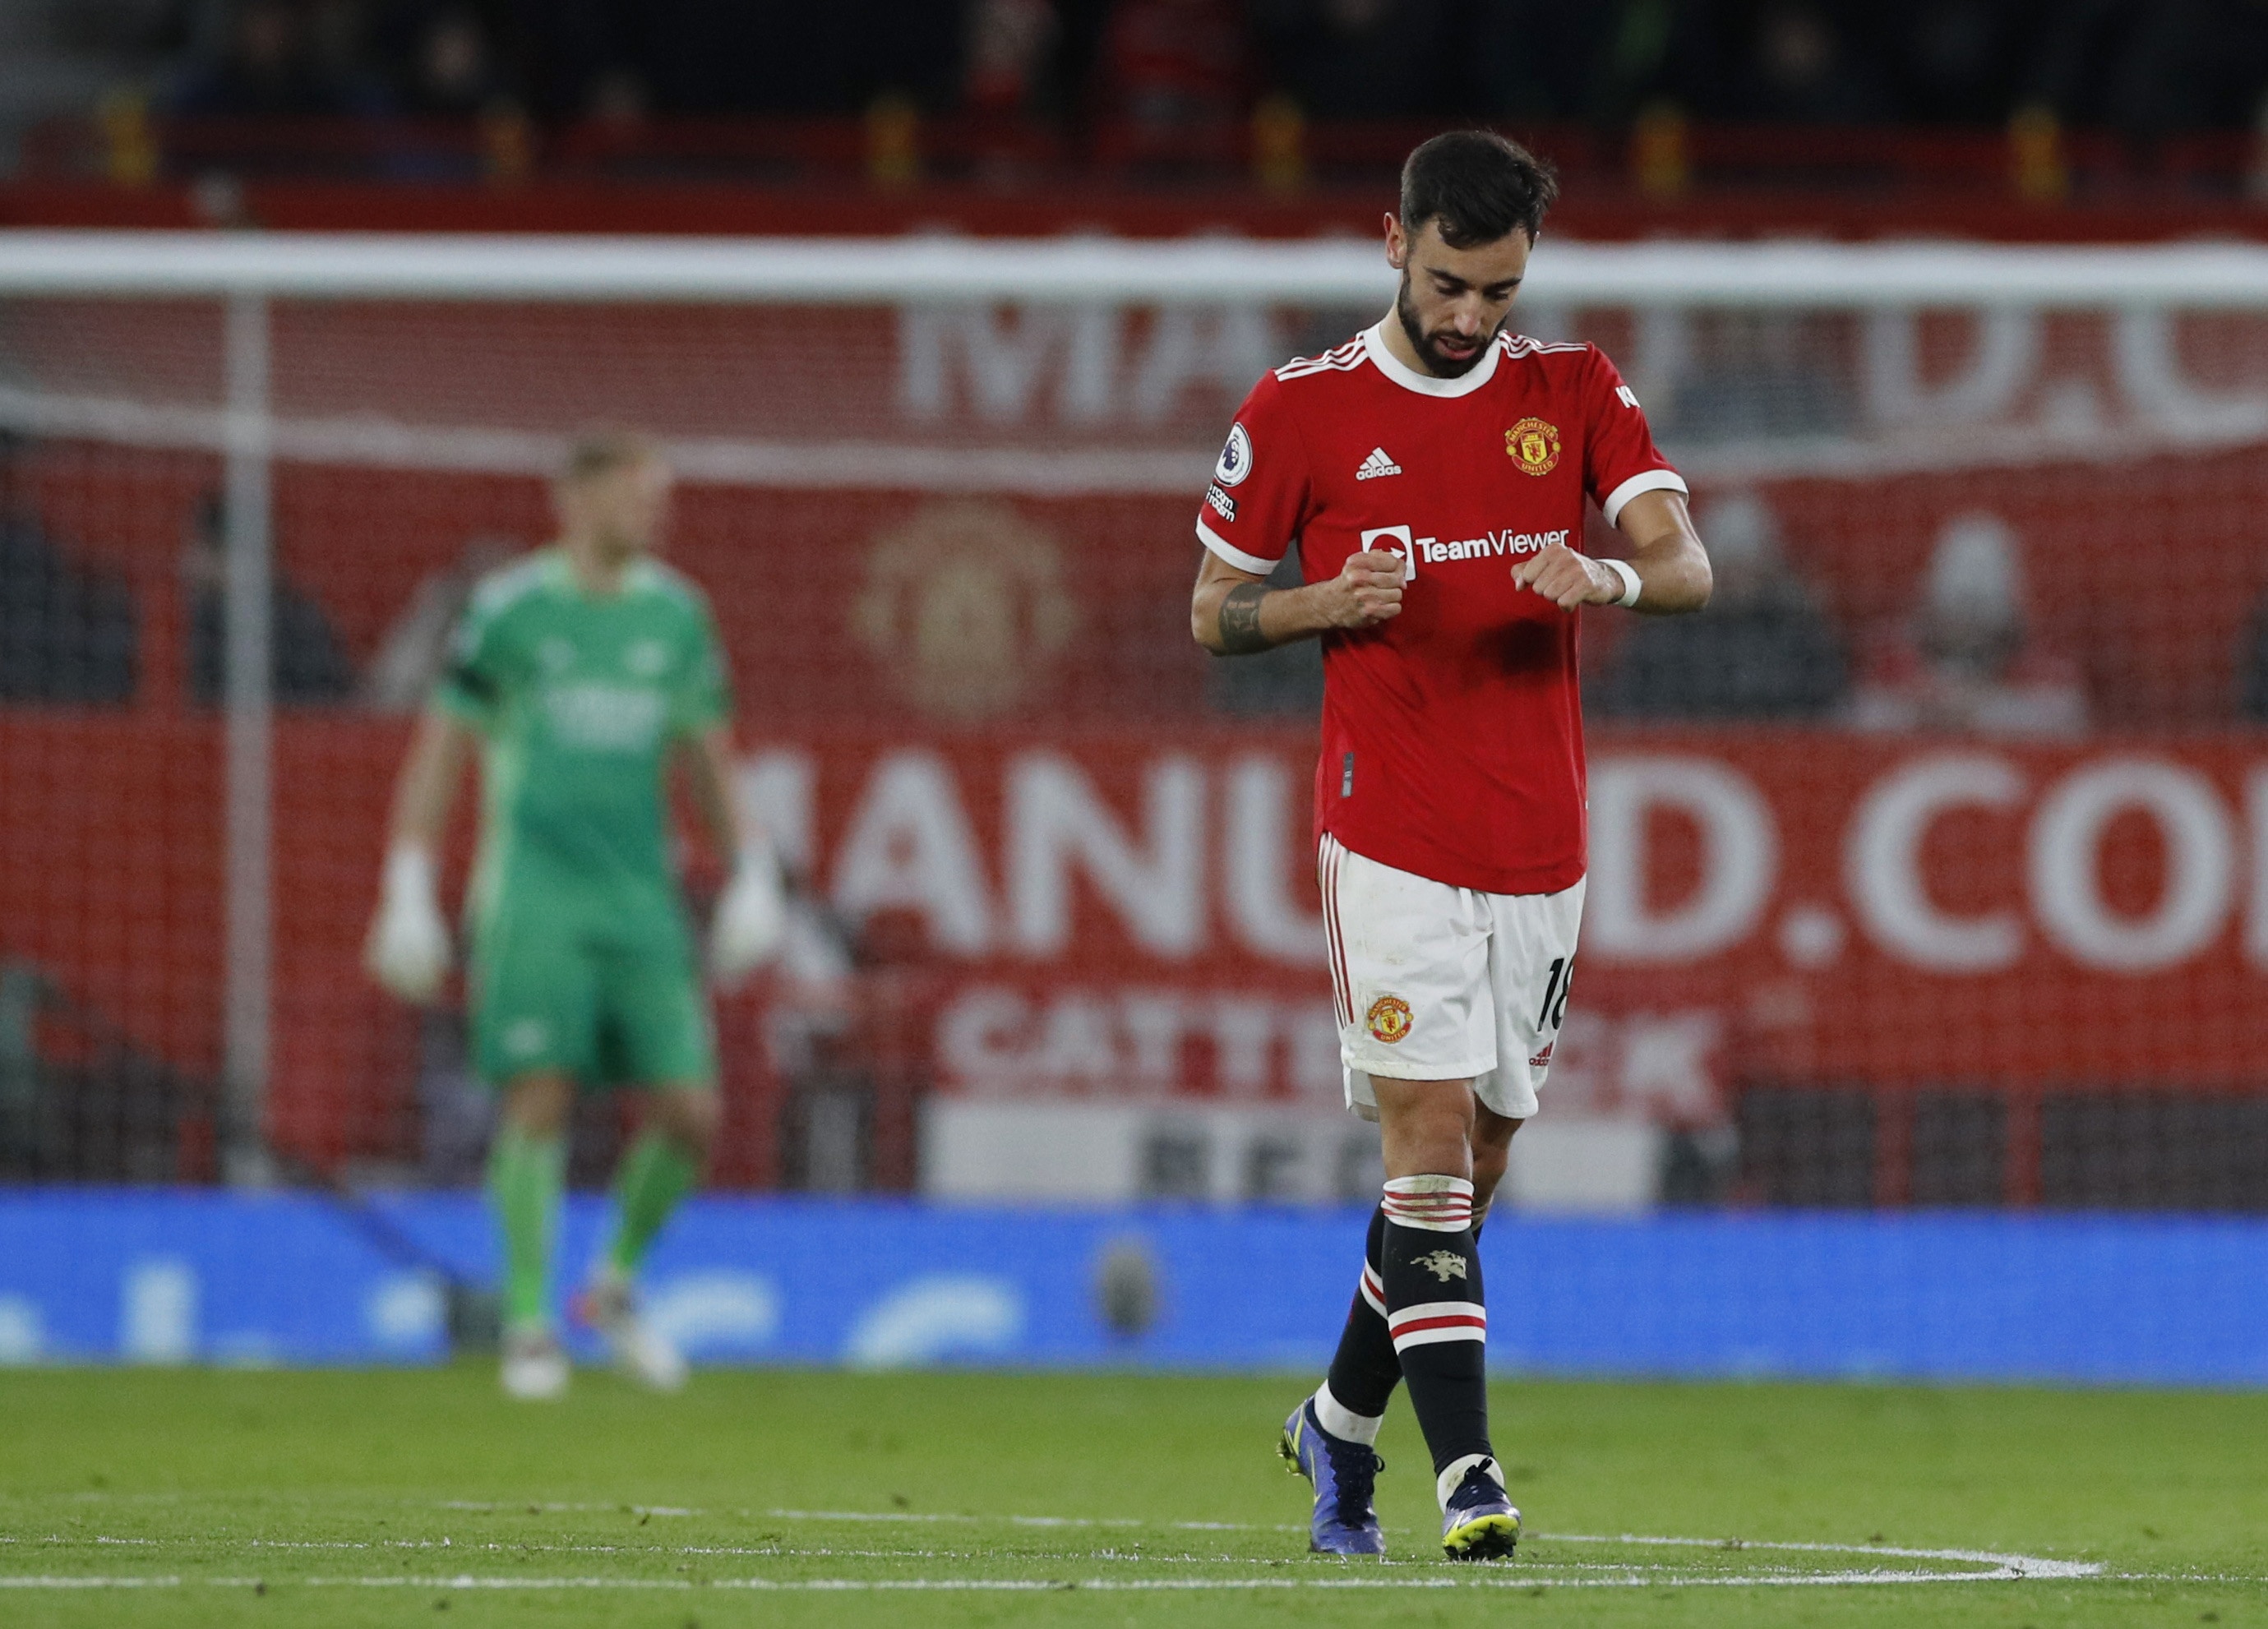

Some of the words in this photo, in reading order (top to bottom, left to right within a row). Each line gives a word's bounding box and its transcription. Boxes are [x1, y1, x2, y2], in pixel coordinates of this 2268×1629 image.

[1509, 422, 1554, 441] MANCHESTER
[1356, 464, 1402, 481] adidas
[1522, 460, 1553, 472] UNITED
[1415, 528, 1569, 563] TeamViewer
